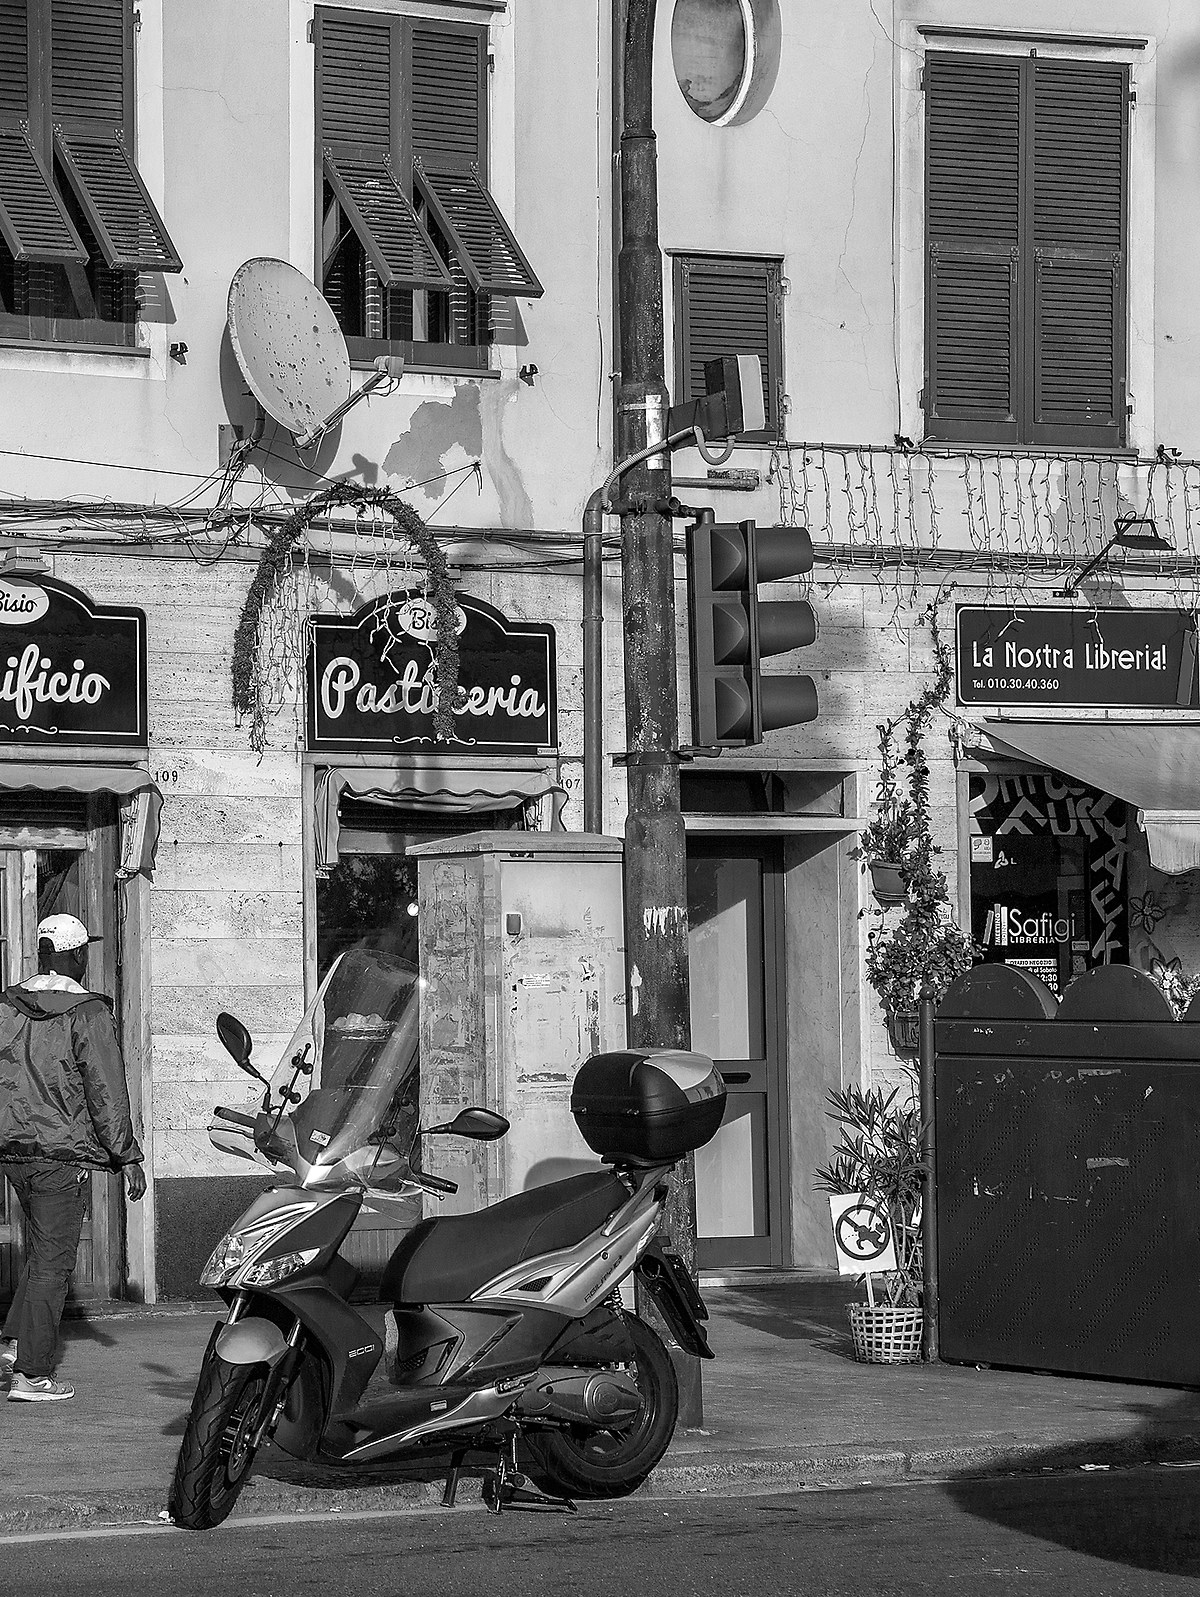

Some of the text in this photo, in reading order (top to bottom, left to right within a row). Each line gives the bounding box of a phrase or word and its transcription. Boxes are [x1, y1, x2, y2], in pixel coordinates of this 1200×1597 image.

[972, 641, 1168, 670] La Nostra Libreria!
[972, 677, 1060, 690] Tel. 010.30.40.360
[154, 770, 178, 782] 109
[875, 781, 897, 801] 27
[1008, 908, 1075, 943] Safigi
[1010, 936, 1055, 944] LIBRERIA
